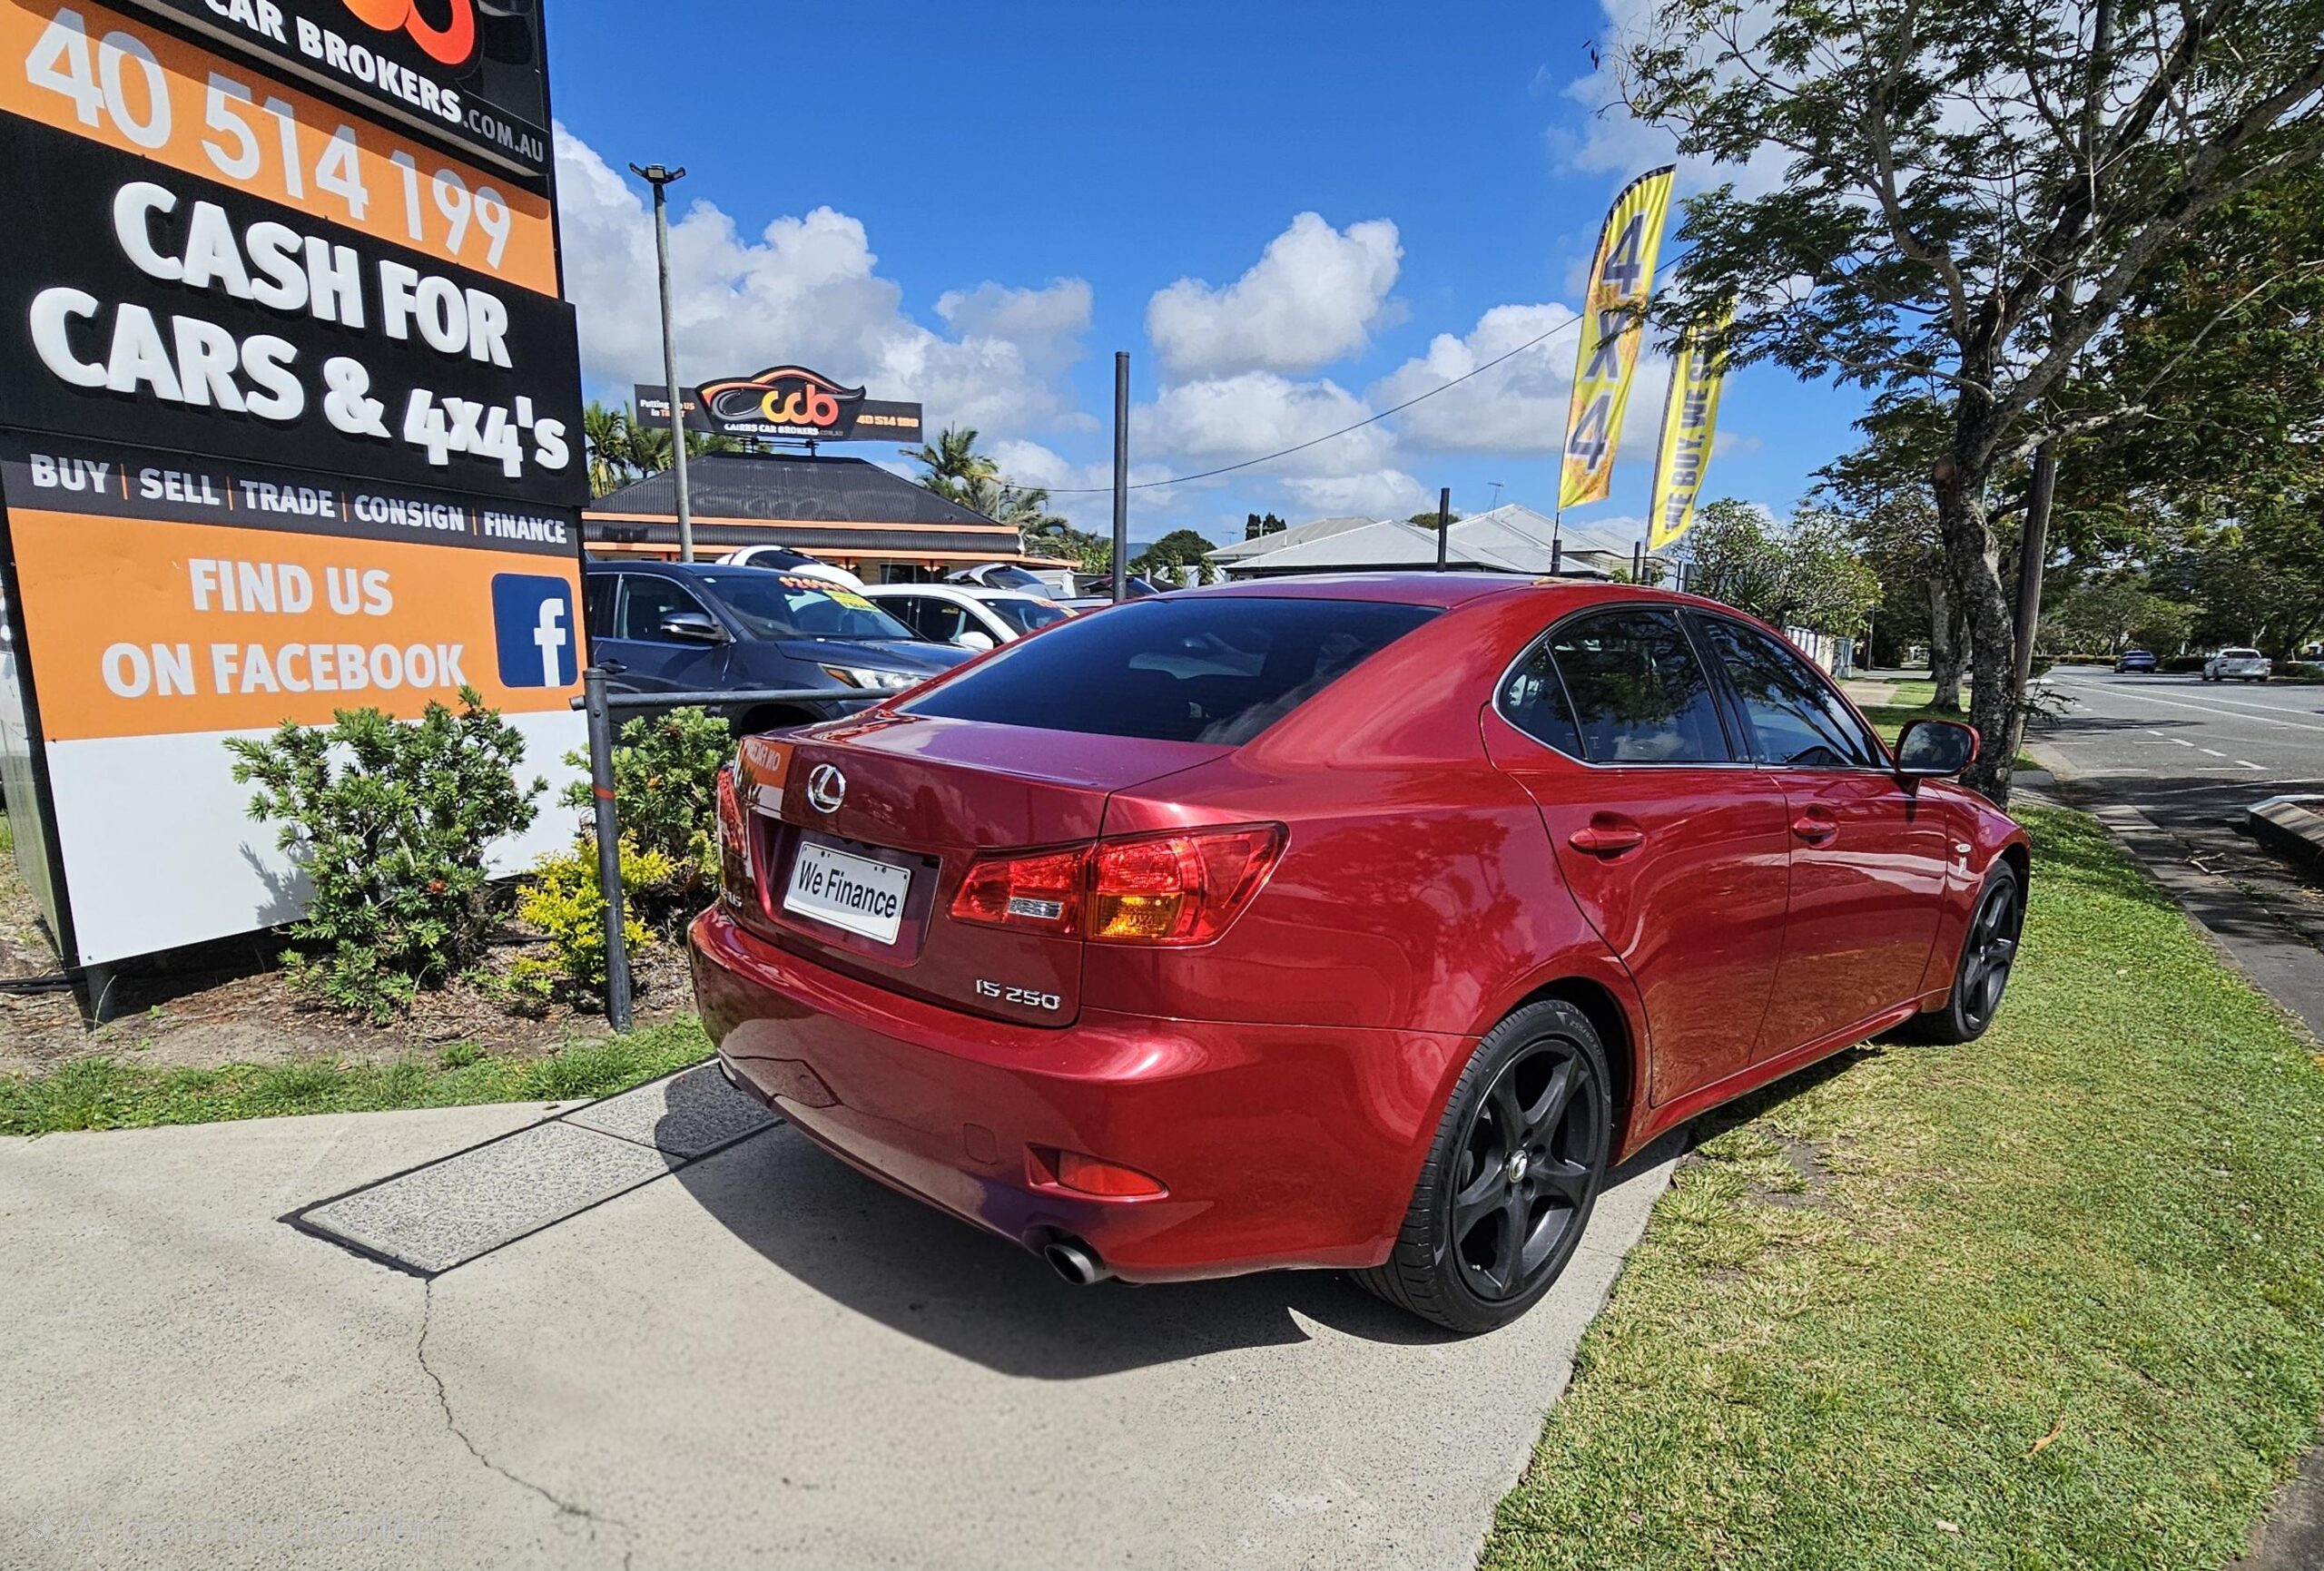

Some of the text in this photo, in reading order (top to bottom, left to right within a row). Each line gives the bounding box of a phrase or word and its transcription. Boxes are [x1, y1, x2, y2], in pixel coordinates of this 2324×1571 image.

[25, 6, 173, 151] 40
[202, 71, 369, 222] 514
[389, 149, 512, 270] 199
[113, 182, 514, 369] CASH FOR
[29, 287, 305, 421] CARS
[323, 356, 392, 439] &
[759, 424, 777, 434] CAR
[1680, 388, 1709, 429] WE
[1670, 433, 1707, 487] BUY,
[30, 454, 567, 545] BUY SELL TRADE CONSIGN FINANCE
[189, 558, 393, 616] FIND US
[102, 643, 467, 698] ON FACEBOOK
[798, 860, 898, 918] We Finance
[976, 979, 1060, 1010] IS 250
